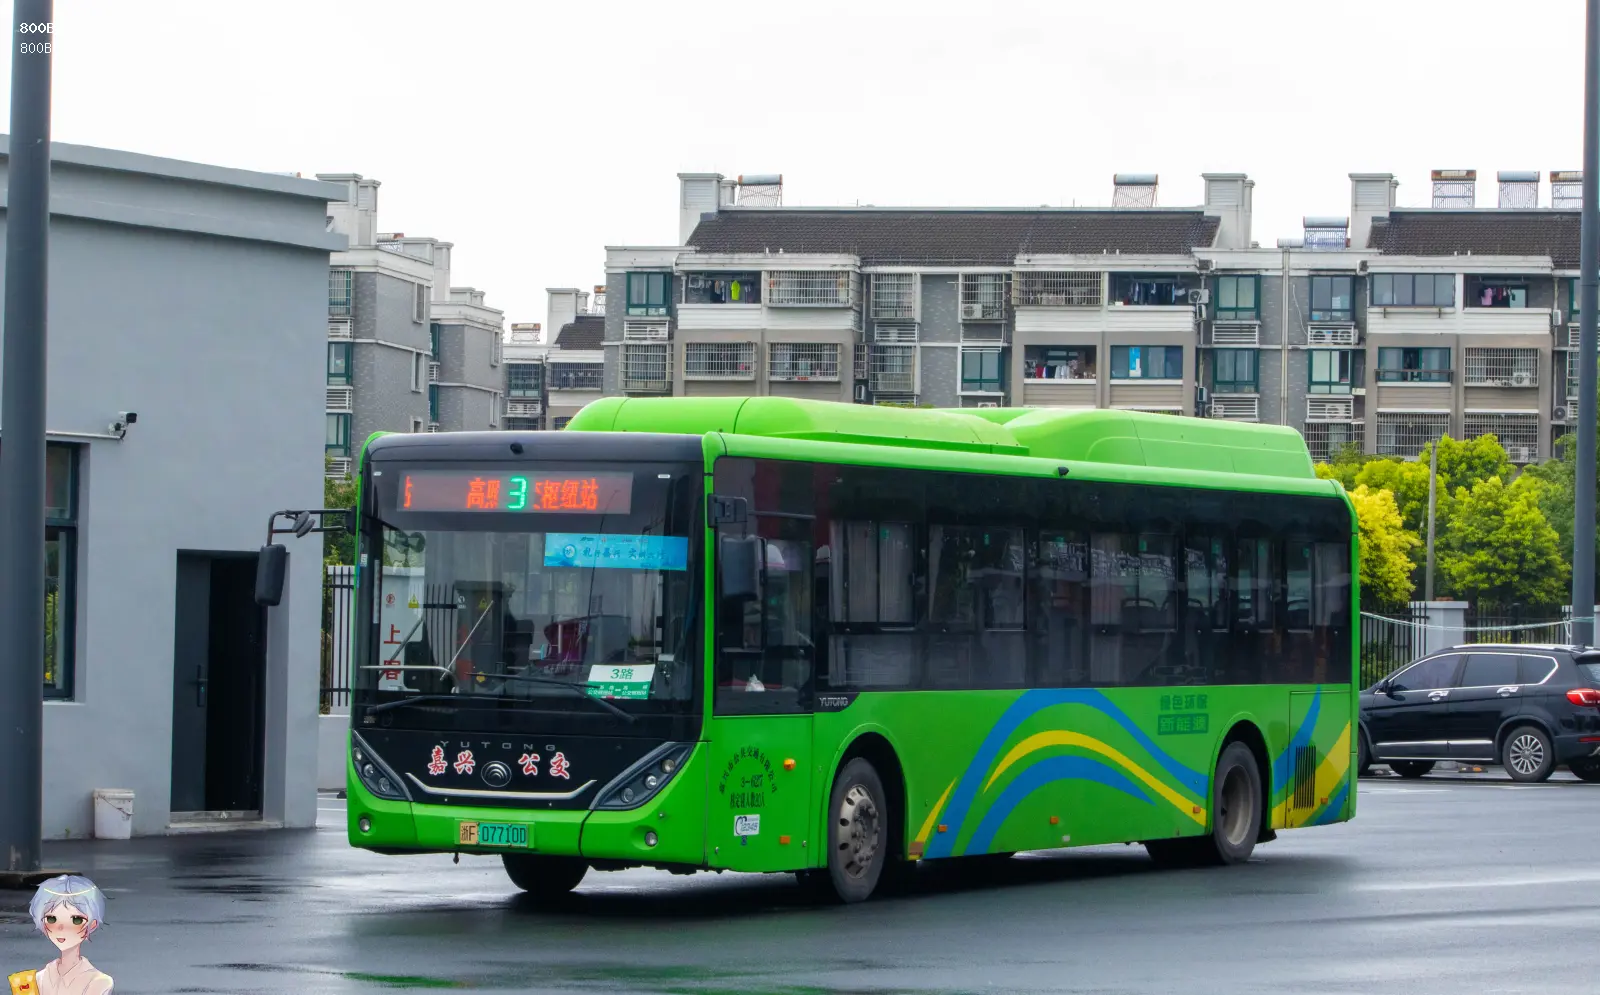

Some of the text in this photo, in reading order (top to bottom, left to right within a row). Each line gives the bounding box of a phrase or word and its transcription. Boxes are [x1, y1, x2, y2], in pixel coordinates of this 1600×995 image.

[508, 476, 527, 509] 3
[610, 668, 633, 679] 3路
[820, 697, 848, 706] YUTONG
[440, 740, 556, 751] YUTONG
